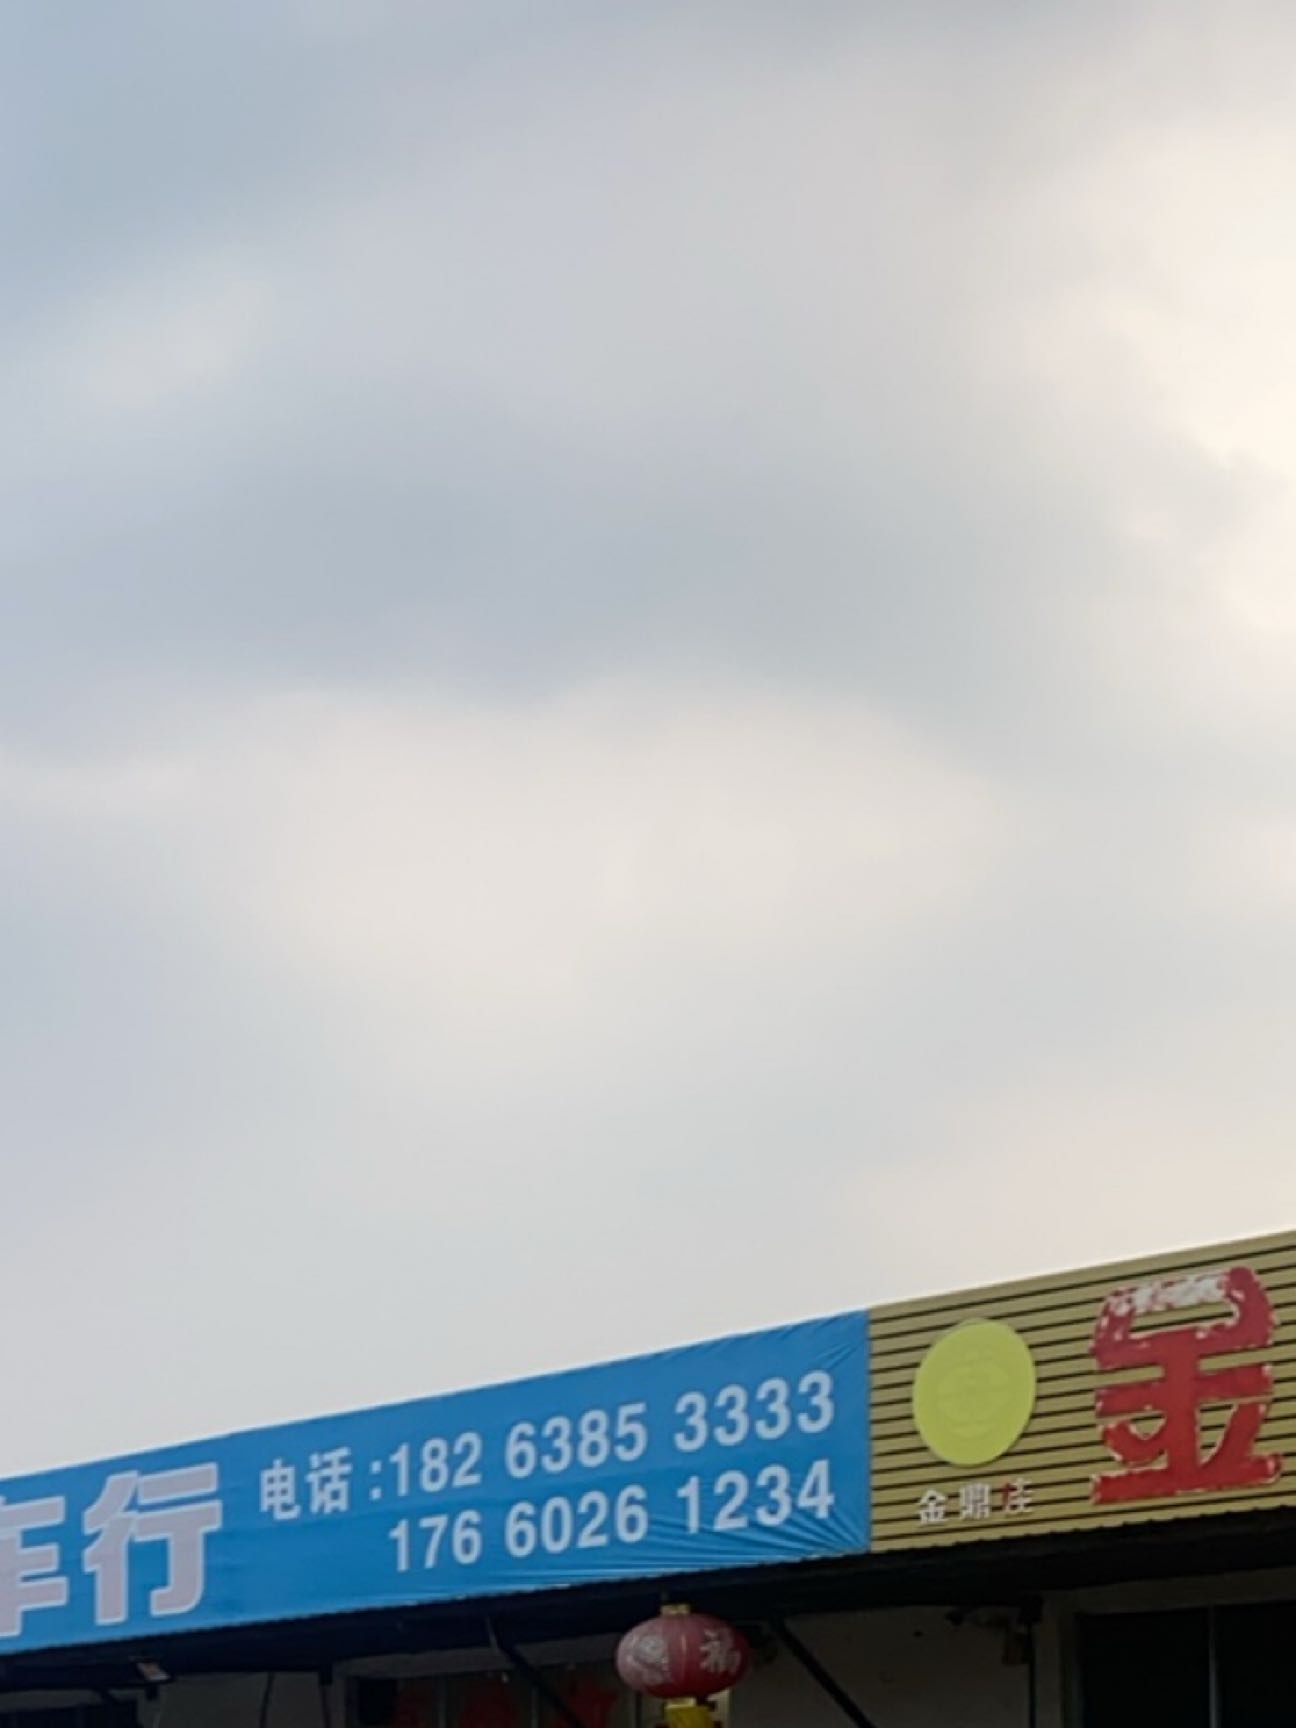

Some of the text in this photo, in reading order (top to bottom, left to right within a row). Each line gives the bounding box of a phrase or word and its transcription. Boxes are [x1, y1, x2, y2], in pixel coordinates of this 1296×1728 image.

[389, 1431, 483, 1497] 182
[505, 1403, 647, 1479] 6385
[674, 1371, 835, 1452] 3333
[1088, 1267, 1283, 1503] 金
[389, 1459, 835, 1572] 176 6026 1234
